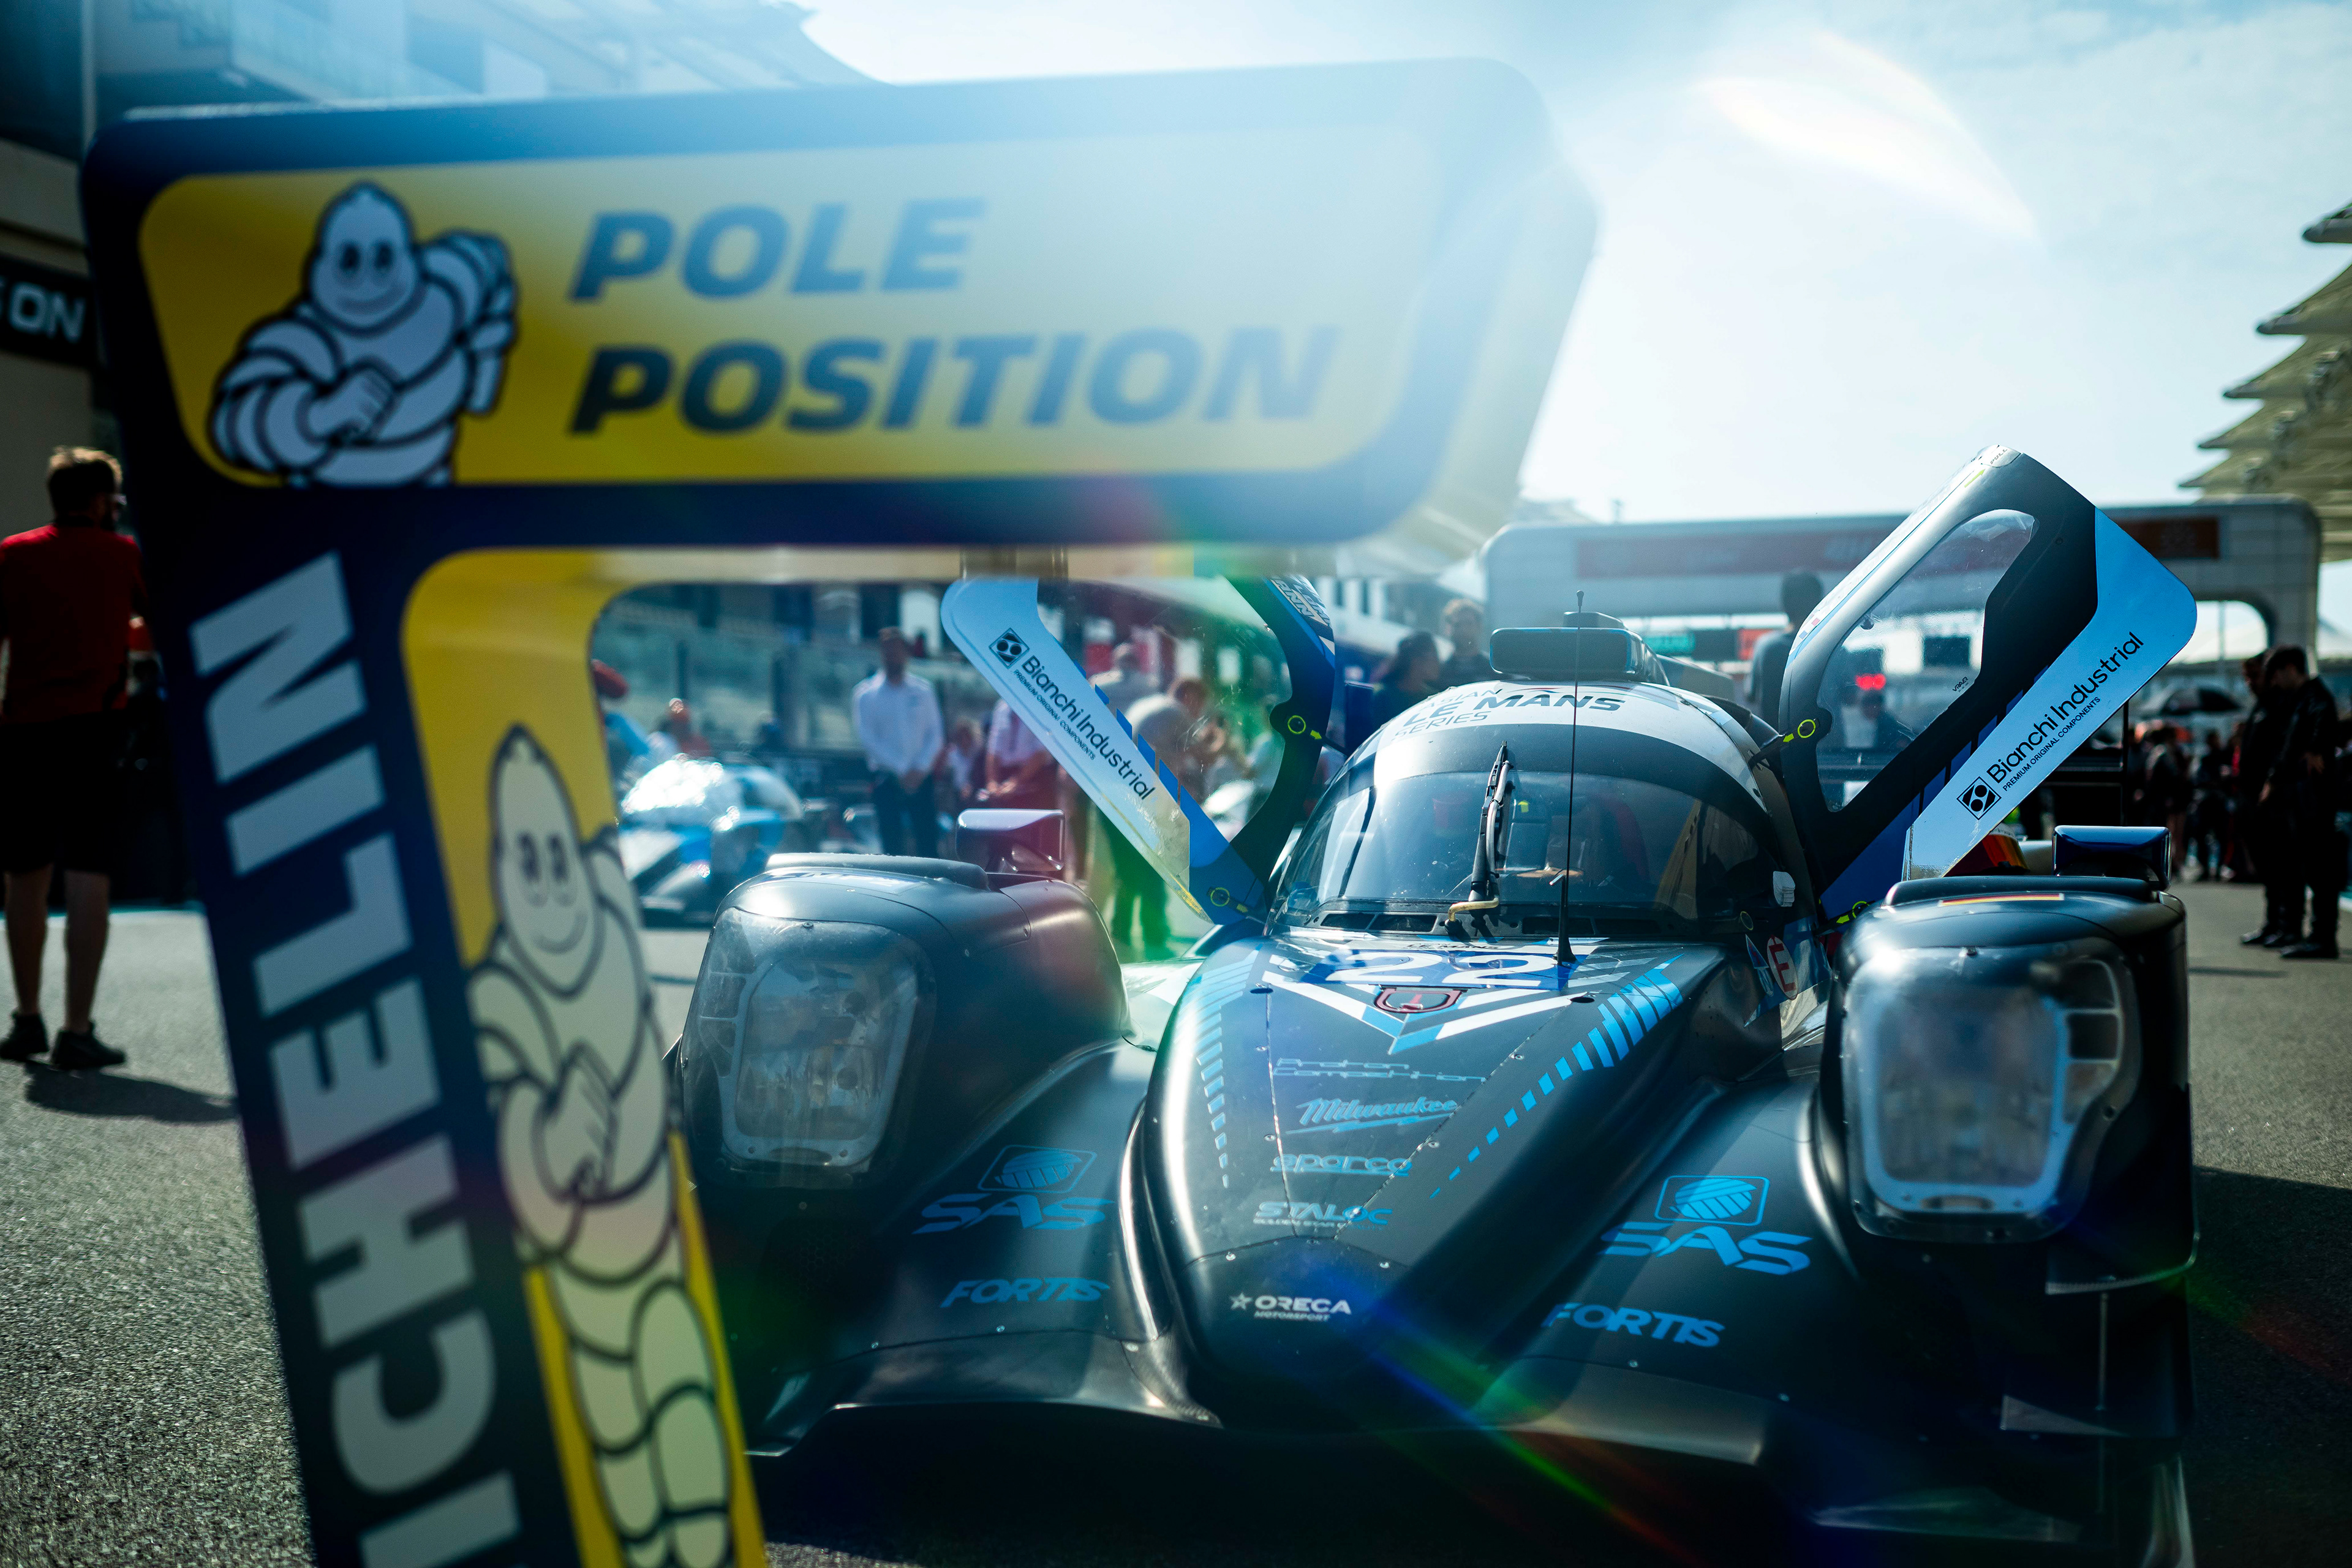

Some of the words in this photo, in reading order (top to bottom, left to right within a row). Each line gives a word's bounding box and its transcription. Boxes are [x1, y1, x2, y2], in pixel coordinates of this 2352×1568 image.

[570, 198, 985, 301] POLE
[570, 326, 1336, 434] POSITION
[1014, 669, 1038, 698] PREMIUM
[1036, 694, 1061, 722] ORIGINAL
[1060, 720, 1096, 761] COMPONENTS
[1022, 655, 1084, 722] Bianchi
[1076, 714, 1156, 800] Industrial
[1395, 710, 1488, 737] SERIES
[1404, 701, 1463, 727] LE
[1473, 694, 1626, 711] MANS
[1986, 714, 2059, 783] Bianchi
[2050, 631, 2144, 720] Industrial
[2002, 763, 2032, 791] PREMIUM
[2030, 737, 2060, 765] ORIGINAL
[2057, 696, 2101, 738] COMPONENTS
[1325, 951, 1559, 986] 22
[191, 550, 522, 1568] ICHELIN
[1295, 1096, 1461, 1126] Milwaukee
[911, 1193, 1115, 1235] SAS
[1255, 1201, 1393, 1226] STALOC
[1596, 1221, 1813, 1275] SAS
[940, 1277, 1110, 1308] FORTIS
[1254, 1295, 1352, 1314] ORECA
[1540, 1302, 1725, 1347] FORTIS
